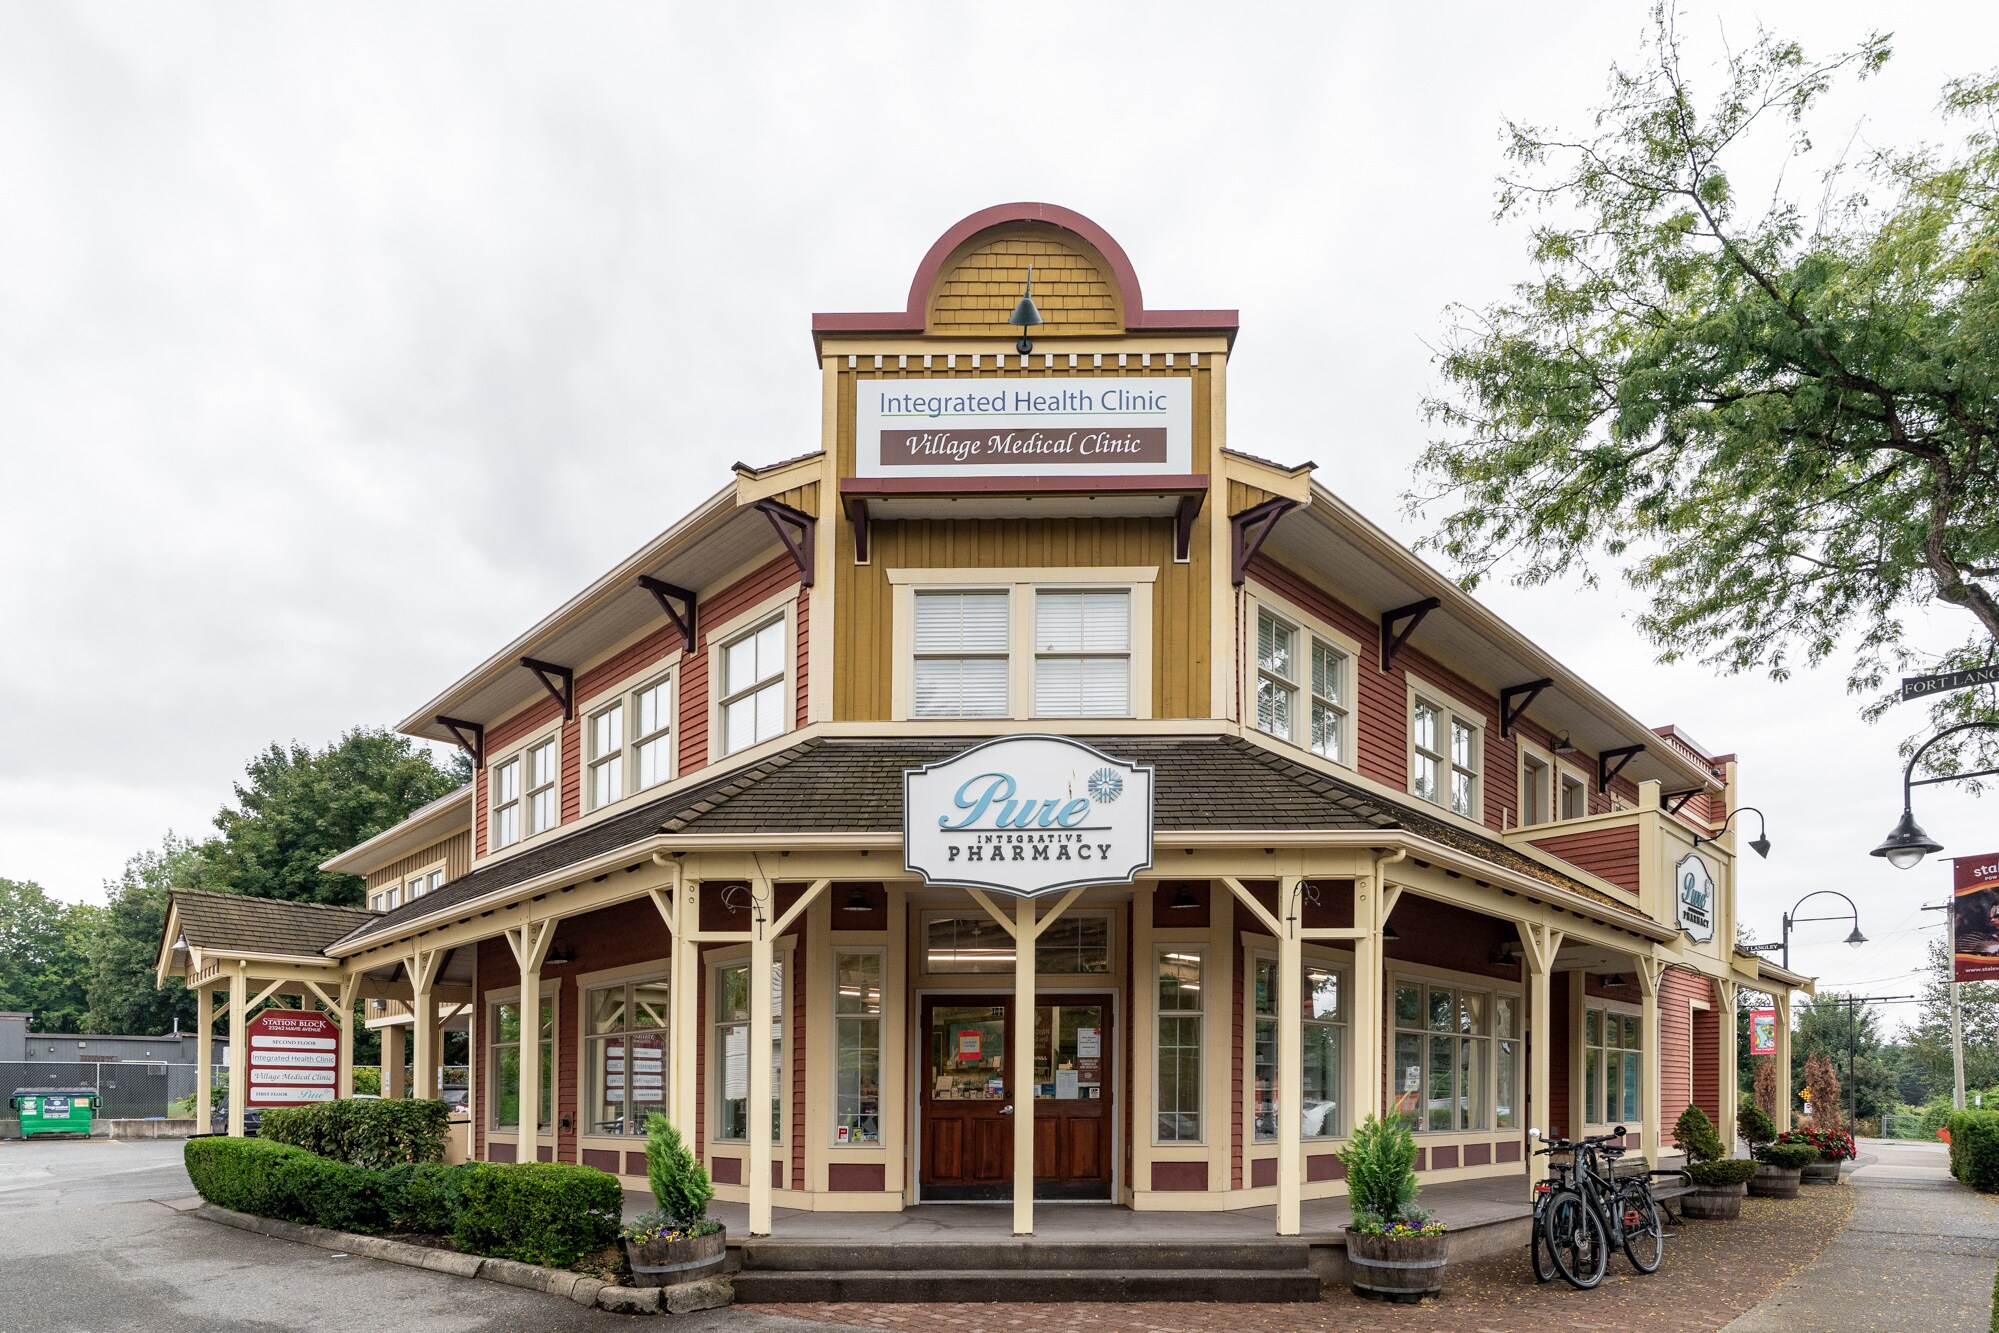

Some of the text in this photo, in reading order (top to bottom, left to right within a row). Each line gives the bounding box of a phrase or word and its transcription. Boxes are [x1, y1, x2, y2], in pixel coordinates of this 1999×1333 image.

[880, 389, 1167, 418] Integrated Health Clinic
[906, 432, 1142, 461] Village Medical Clinic
[1904, 677, 1949, 695] FORT
[938, 772, 1091, 829] Pure
[977, 834, 1083, 843] INTEGRATIVE
[948, 844, 1112, 861] PHARMACY
[1681, 872, 1707, 909] Pure
[1682, 910, 1710, 929] PHARMACY
[262, 1018, 326, 1028] STATION BLOCK
[252, 1054, 290, 1062] Integrated
[254, 1072, 281, 1081] Village
[297, 1089, 324, 1099] Pure
